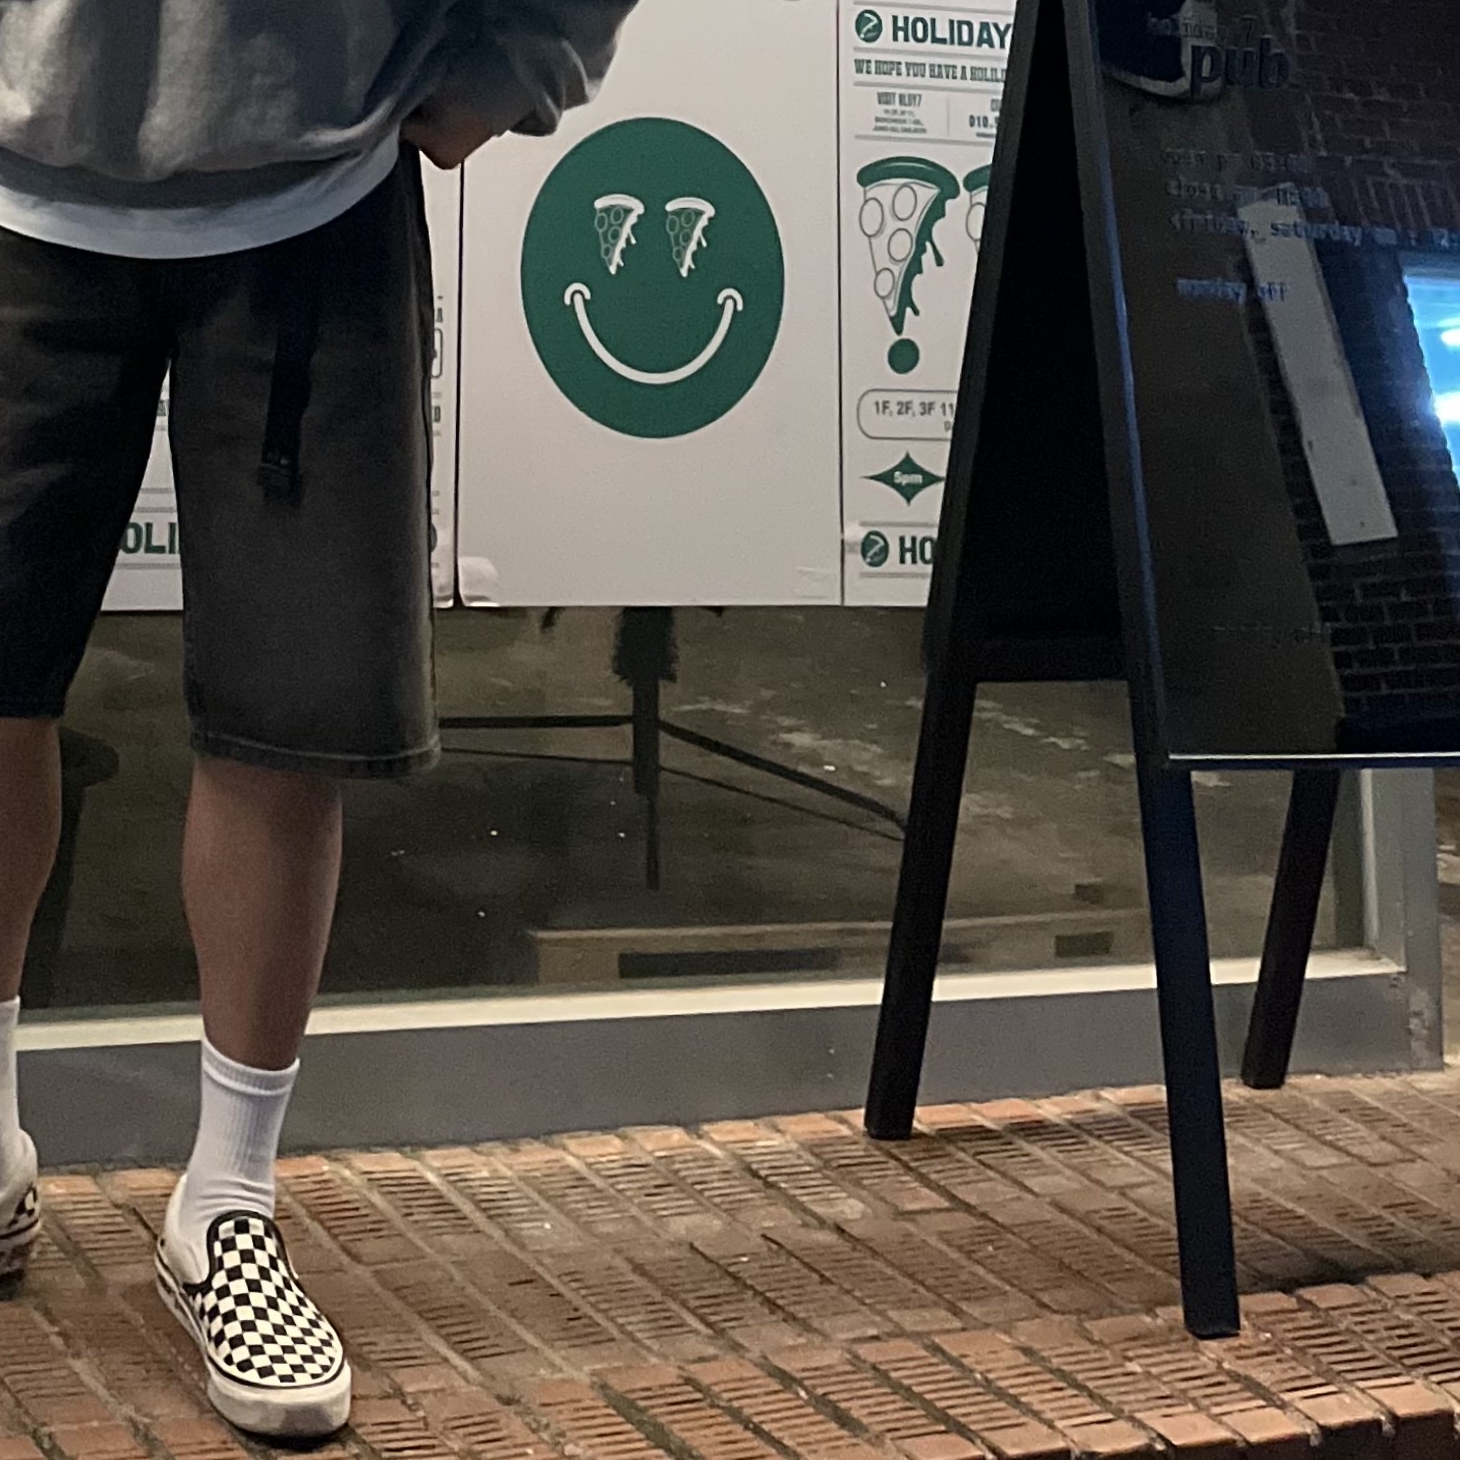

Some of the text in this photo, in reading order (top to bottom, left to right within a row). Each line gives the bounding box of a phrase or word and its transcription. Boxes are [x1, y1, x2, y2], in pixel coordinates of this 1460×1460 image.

[854, 59, 872, 75] WE
[874, 59, 902, 78] HOPE
[905, 61, 927, 78] YOU
[929, 63, 957, 80] HAVE
[960, 65, 968, 81] A
[1189, 34, 1291, 98] pub
[919, 401, 936, 416] 3F
[894, 471, 923, 487] 5pm
